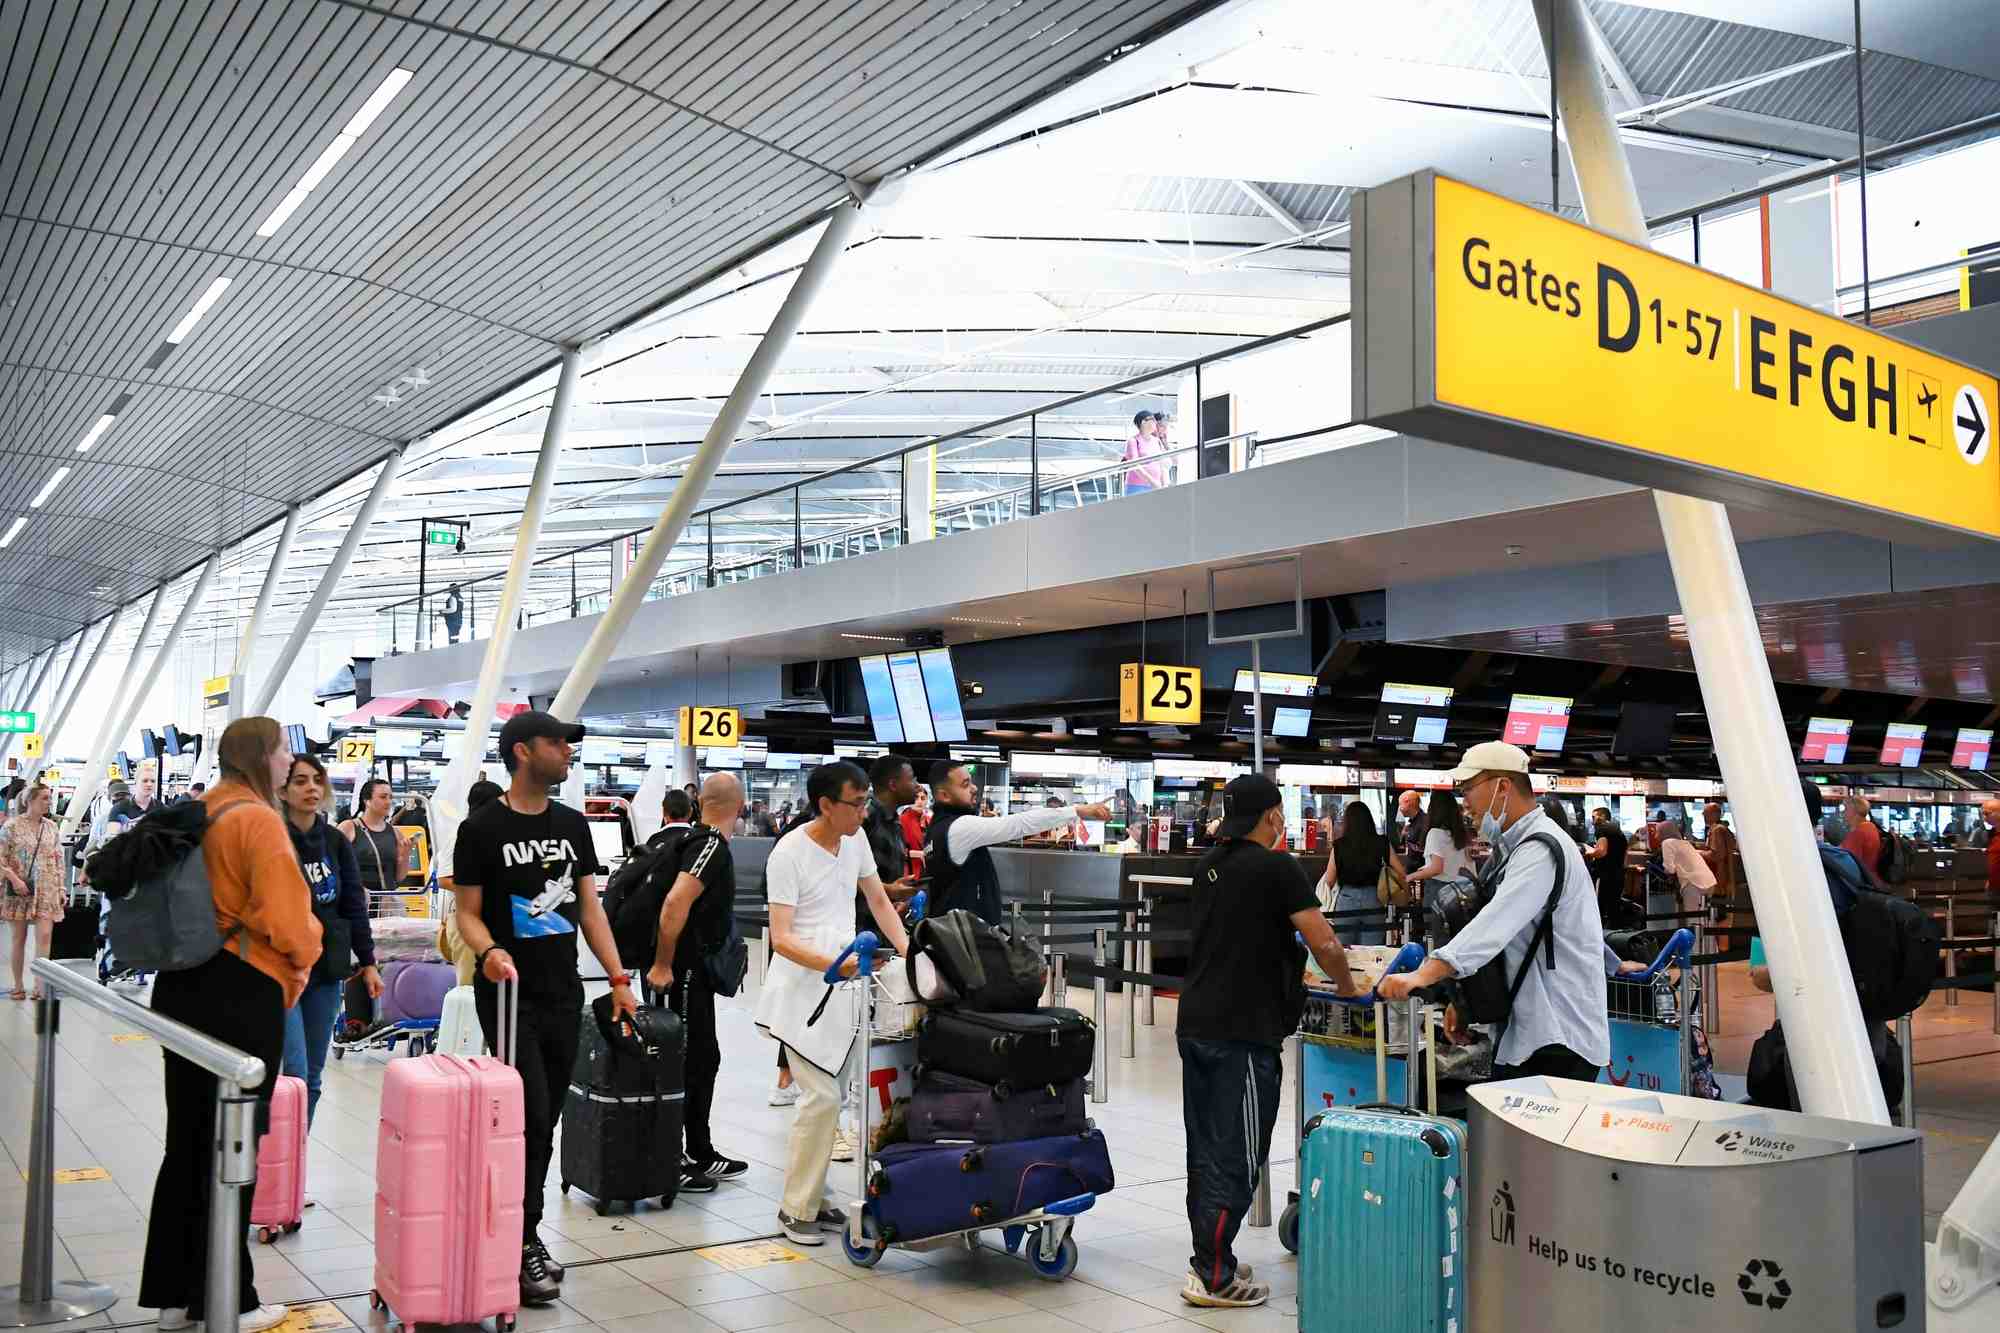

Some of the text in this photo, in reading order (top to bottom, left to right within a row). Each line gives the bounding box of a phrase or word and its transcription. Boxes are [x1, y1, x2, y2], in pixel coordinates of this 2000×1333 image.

[1462, 237, 1581, 318] Gates
[1151, 670, 1193, 709] 25
[699, 711, 731, 737] 26
[346, 742, 370, 757] 27
[502, 839, 578, 867] NASA
[1637, 1071, 1662, 1091] TUI
[1526, 1100, 1560, 1113] Paper
[1628, 1117, 1672, 1133] Plastic
[1749, 1135, 1795, 1152] Waste
[1528, 1234, 1715, 1298] Help us to recycle
